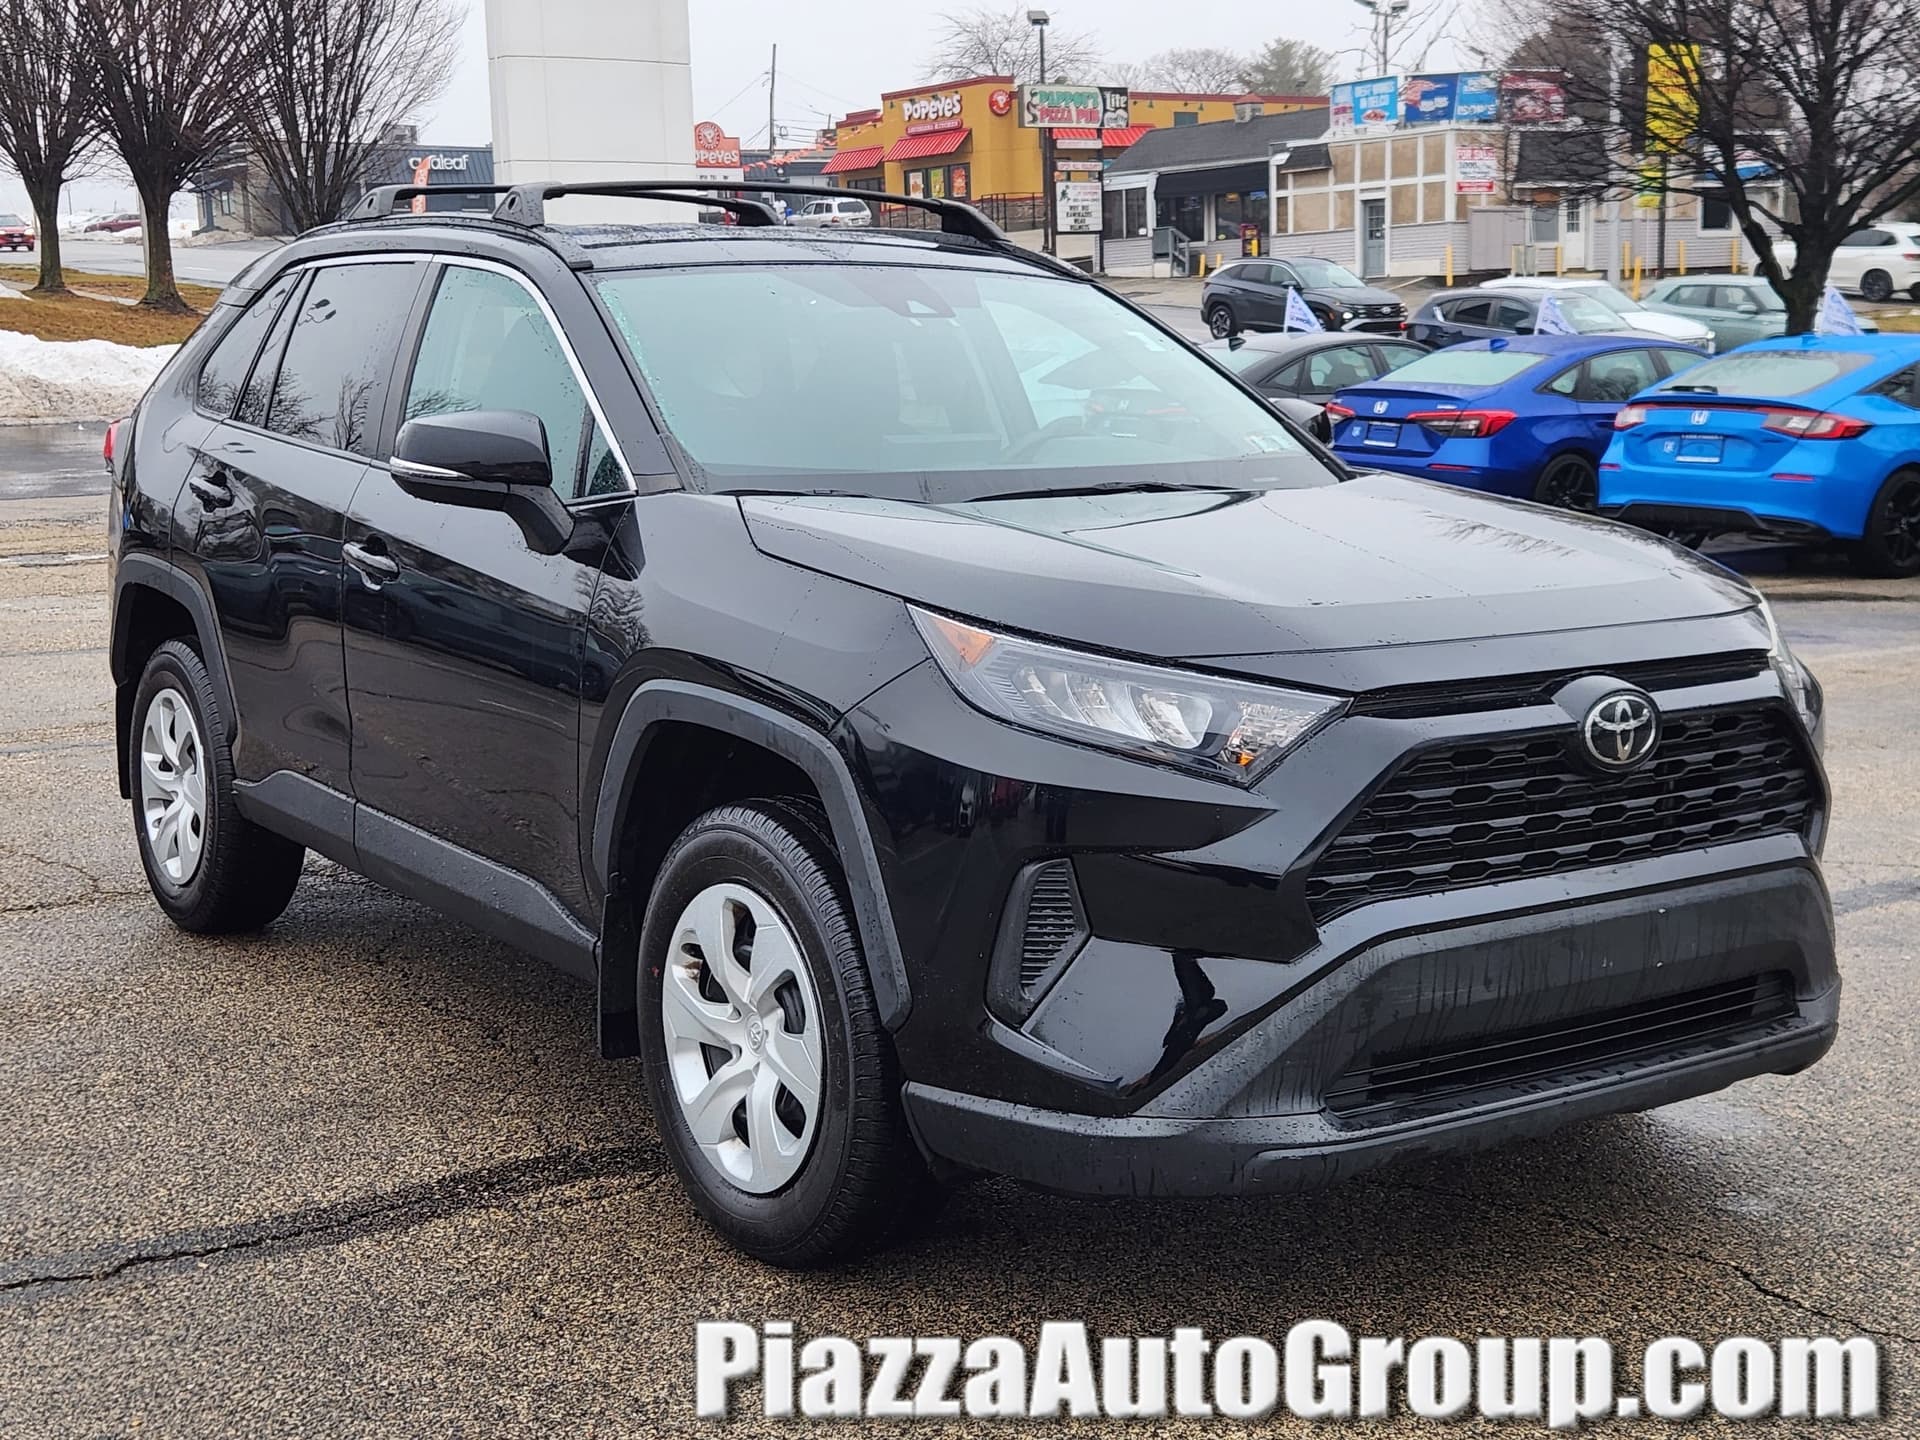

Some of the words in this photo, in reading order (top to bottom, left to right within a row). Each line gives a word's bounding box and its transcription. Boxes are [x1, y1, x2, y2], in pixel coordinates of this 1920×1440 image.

[903, 94, 961, 121] POPEYES
[1103, 91, 1128, 111] Lite
[1039, 107, 1073, 124] PIZZA
